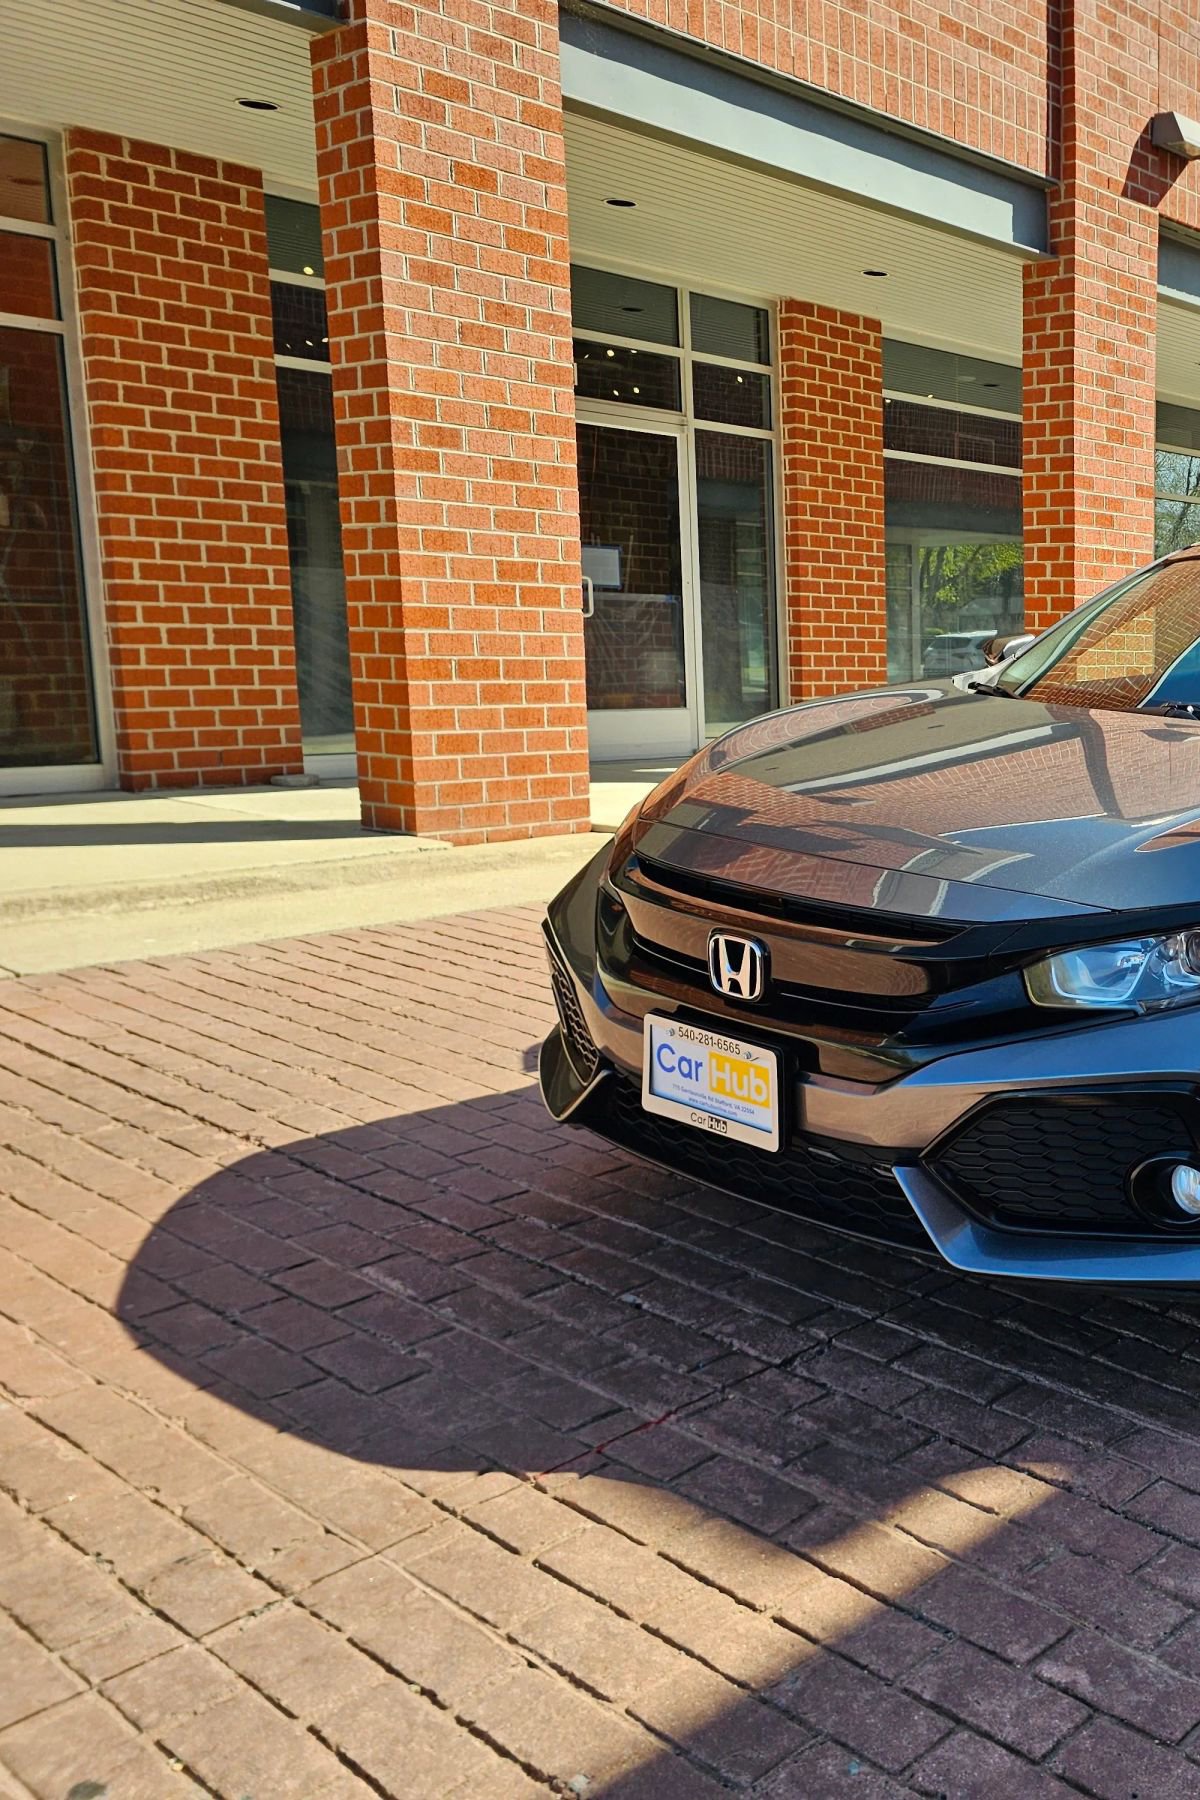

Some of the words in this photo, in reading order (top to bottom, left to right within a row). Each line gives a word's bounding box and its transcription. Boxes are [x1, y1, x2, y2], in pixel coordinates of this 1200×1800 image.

[678, 1026, 741, 1055] 540-281-6565
[656, 1043, 703, 1081] Car
[710, 1058, 769, 1104] Hub
[690, 1112, 706, 1125] Car
[708, 1116, 727, 1133] Hub
